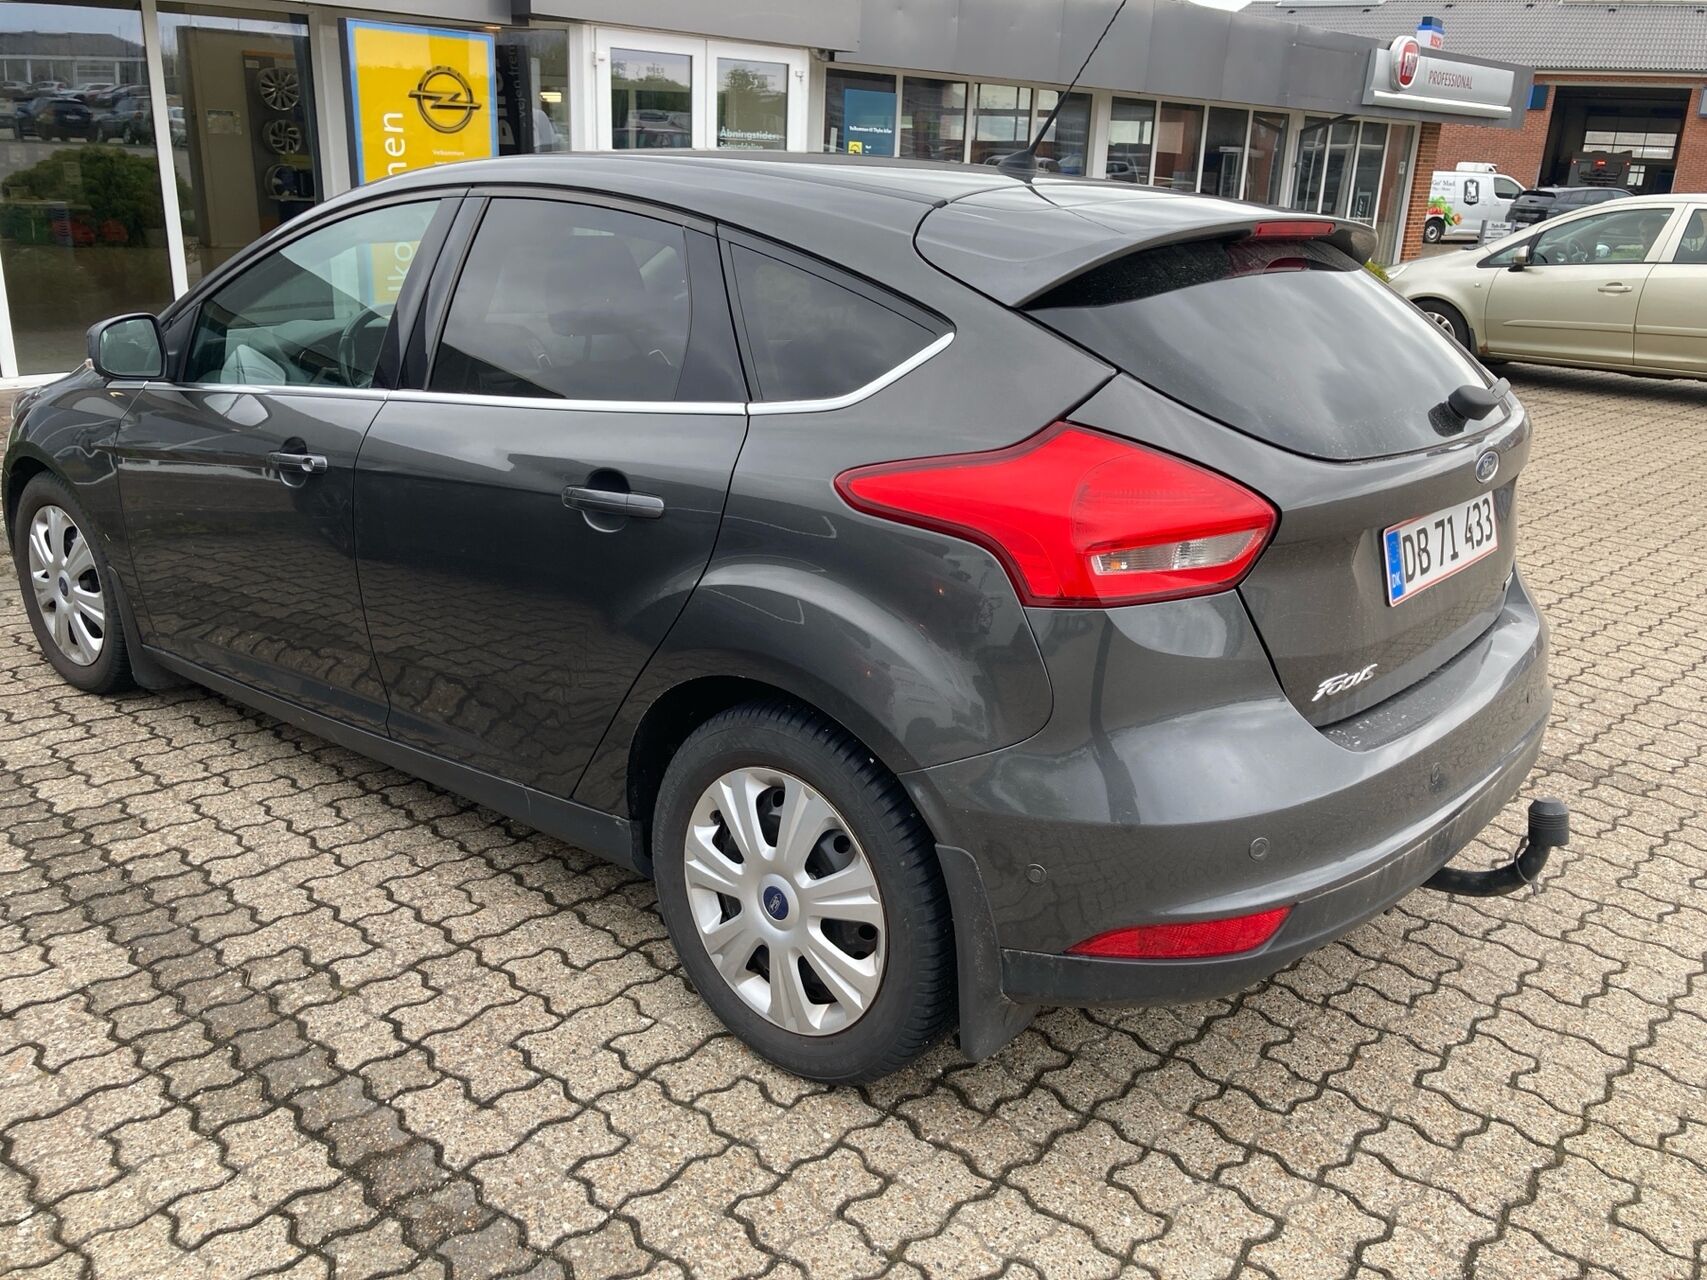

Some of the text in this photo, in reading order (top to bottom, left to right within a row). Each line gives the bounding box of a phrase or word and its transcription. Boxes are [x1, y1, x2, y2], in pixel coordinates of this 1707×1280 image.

[1428, 70, 1473, 89] PROFESSIONAL
[1402, 497, 1493, 584] DB 71 433
[1391, 571, 1401, 588] DK
